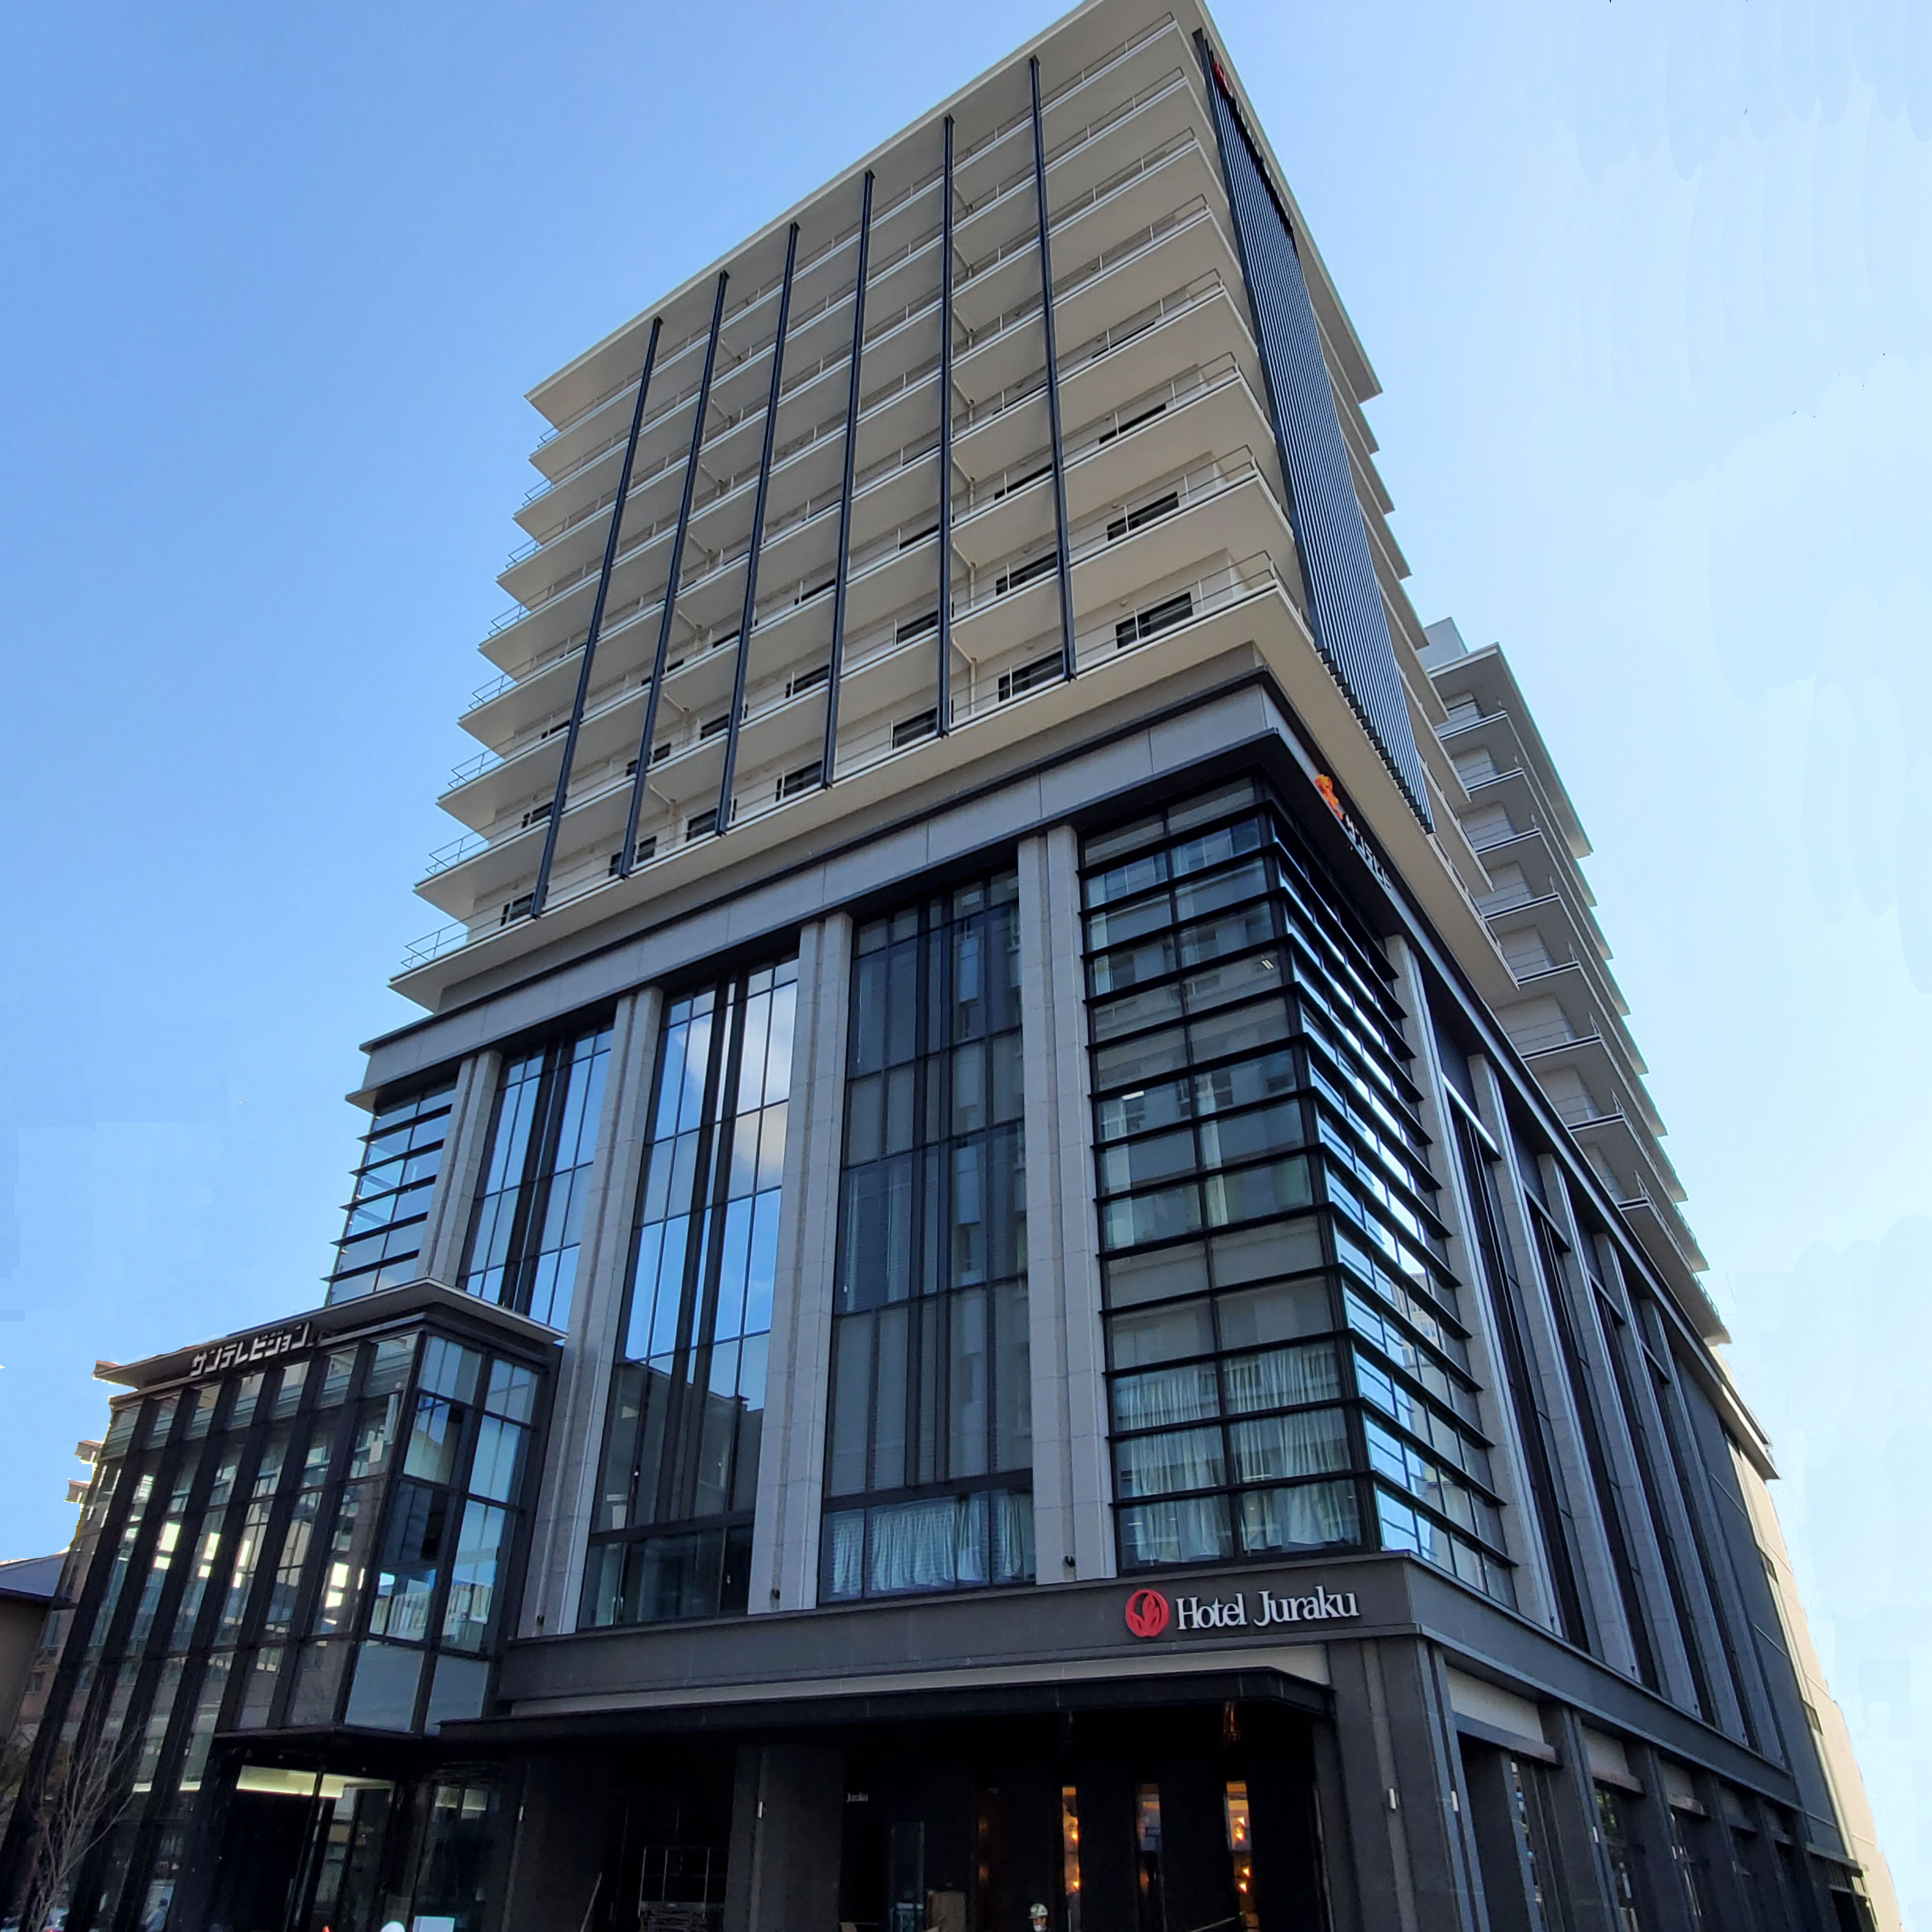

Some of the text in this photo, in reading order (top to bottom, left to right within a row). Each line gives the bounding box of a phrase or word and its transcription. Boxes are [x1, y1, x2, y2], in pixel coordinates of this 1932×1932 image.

[190, 1322, 310, 1377] サンテレビジョン
[1176, 1585, 1360, 1631] Hotel Juraku
